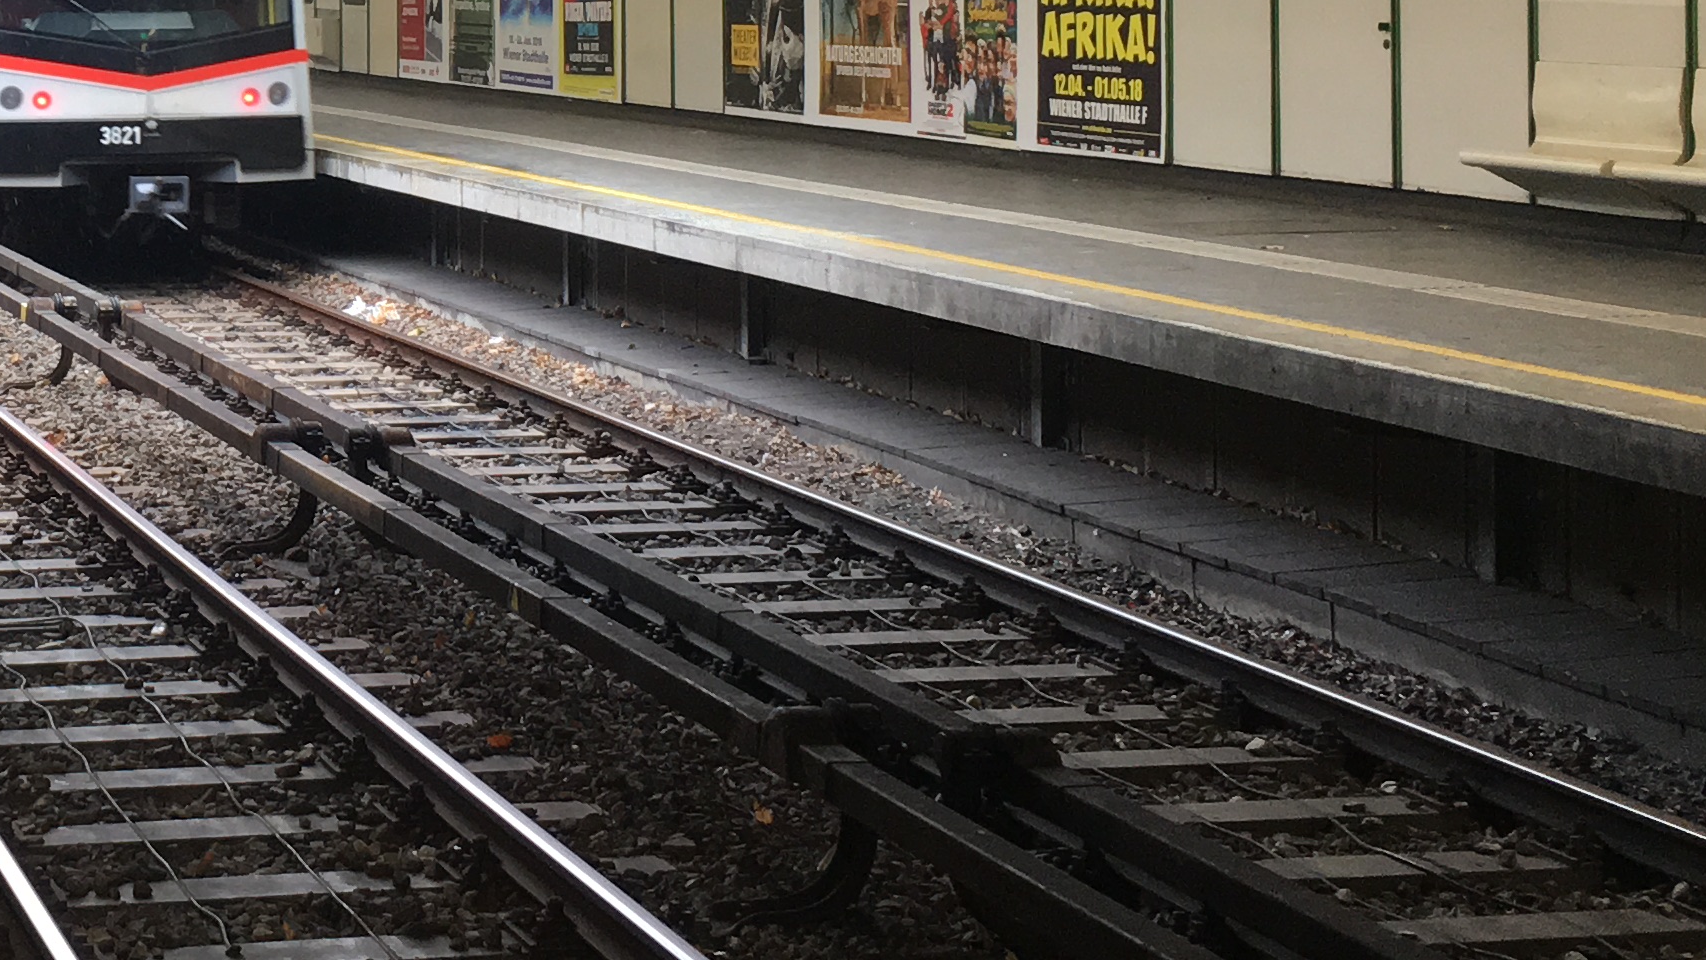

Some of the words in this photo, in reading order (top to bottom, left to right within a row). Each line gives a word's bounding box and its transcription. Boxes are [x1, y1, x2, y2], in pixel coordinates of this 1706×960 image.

[1041, 10, 1156, 64] AFRIKA!
[1054, 73, 1086, 96] 12.04.
[1094, 76, 1143, 101] 01.05.18
[947, 103, 954, 118] 2
[1049, 98, 1083, 119] WIENER
[1084, 101, 1141, 124] STADTHALLE
[1141, 106, 1148, 125] F
[99, 125, 141, 145] 3821
